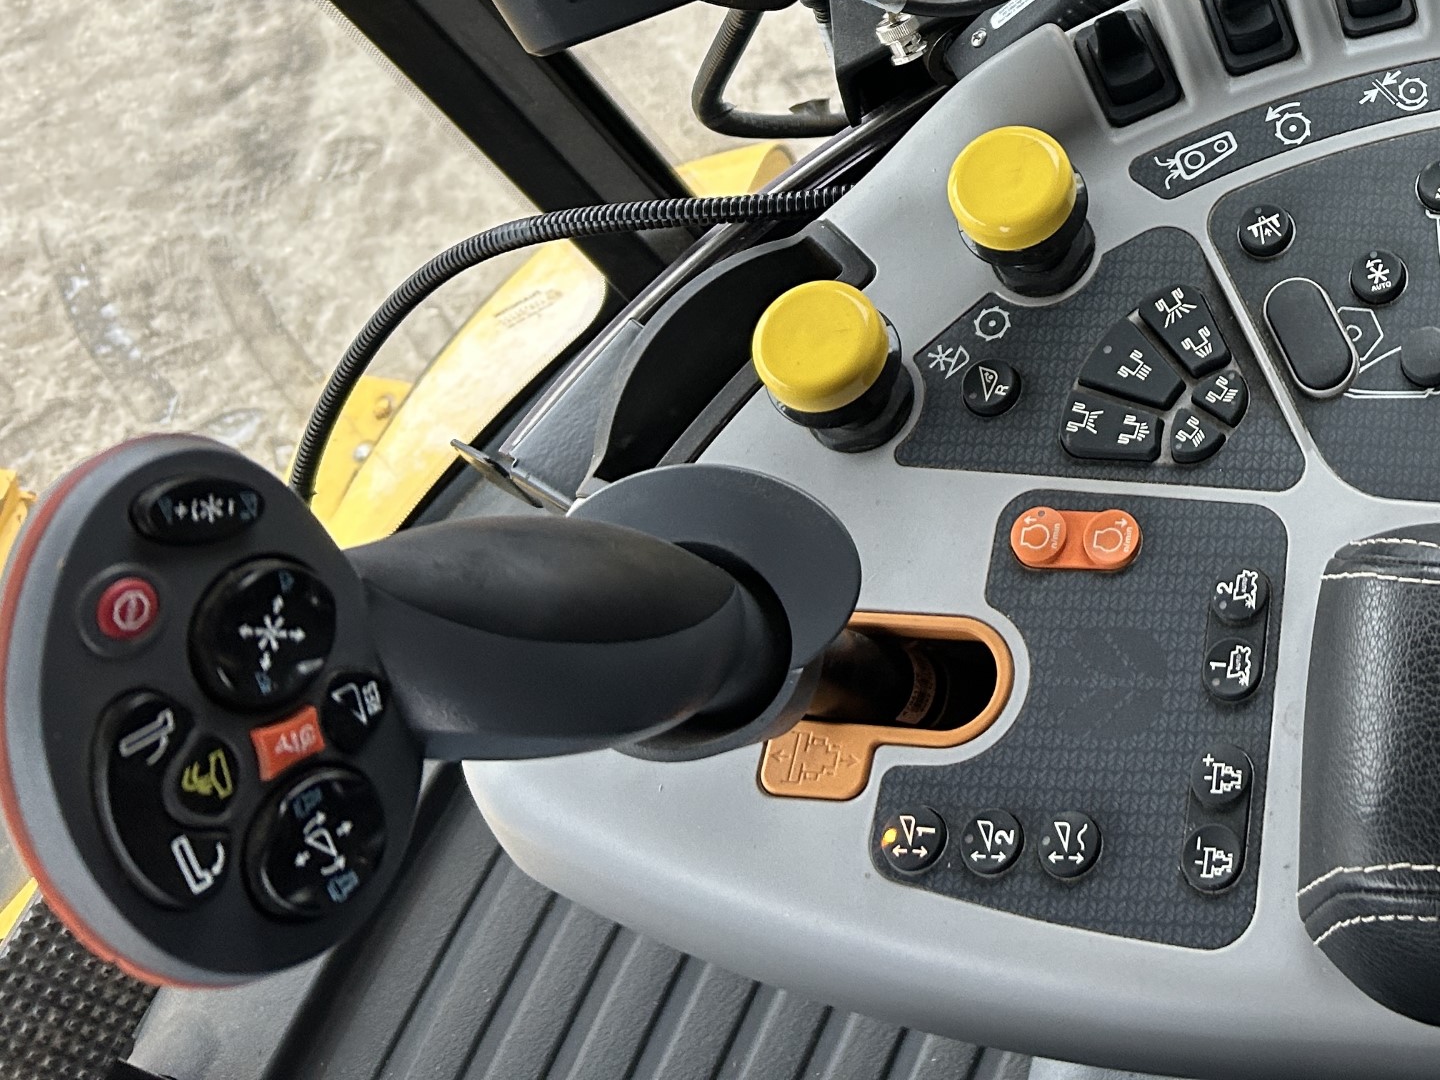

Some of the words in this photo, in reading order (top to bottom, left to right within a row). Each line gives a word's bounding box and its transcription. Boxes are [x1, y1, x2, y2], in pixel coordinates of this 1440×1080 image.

[1371, 281, 1392, 292] AUTO
[994, 383, 1009, 396] R
[1216, 581, 1234, 594] 2
[1209, 661, 1227, 671] 1
[916, 826, 936, 837] 1
[994, 829, 1015, 845] 2
